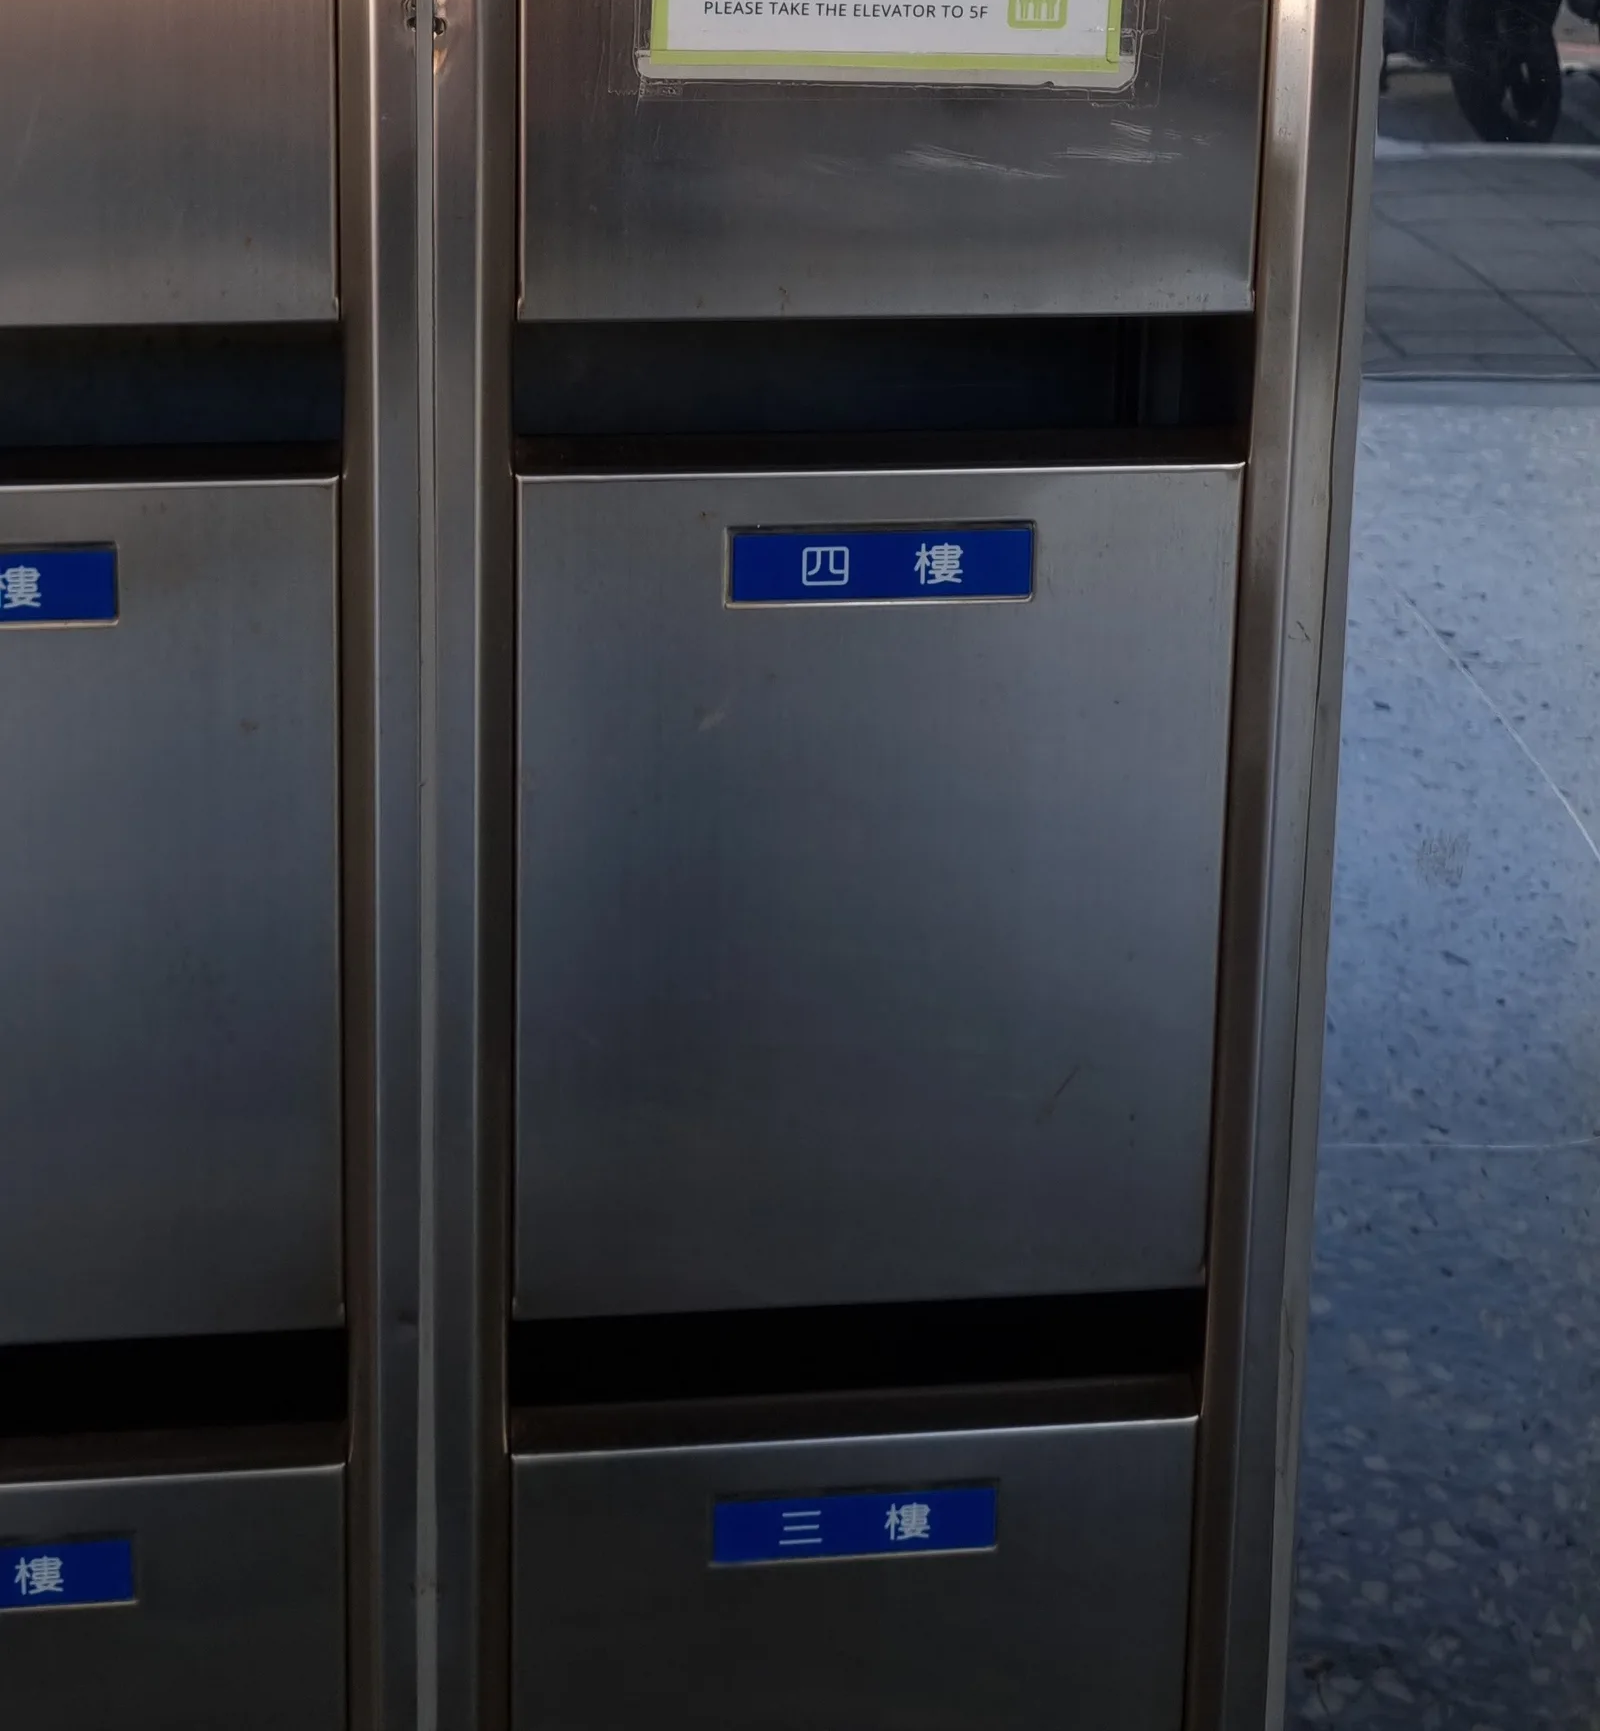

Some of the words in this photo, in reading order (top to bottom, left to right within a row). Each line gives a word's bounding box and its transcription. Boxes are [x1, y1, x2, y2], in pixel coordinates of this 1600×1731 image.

[703, 0, 764, 16] PLEASE
[768, 1, 810, 16] TAKE
[815, 2, 848, 17] THE
[852, 3, 937, 19] ELEVATOR
[941, 4, 965, 19] TO
[968, 5, 989, 19] 5F
[801, 541, 965, 587] 四樓
[778, 1501, 932, 1546] 三樓
[14, 1554, 65, 1597] 樓
